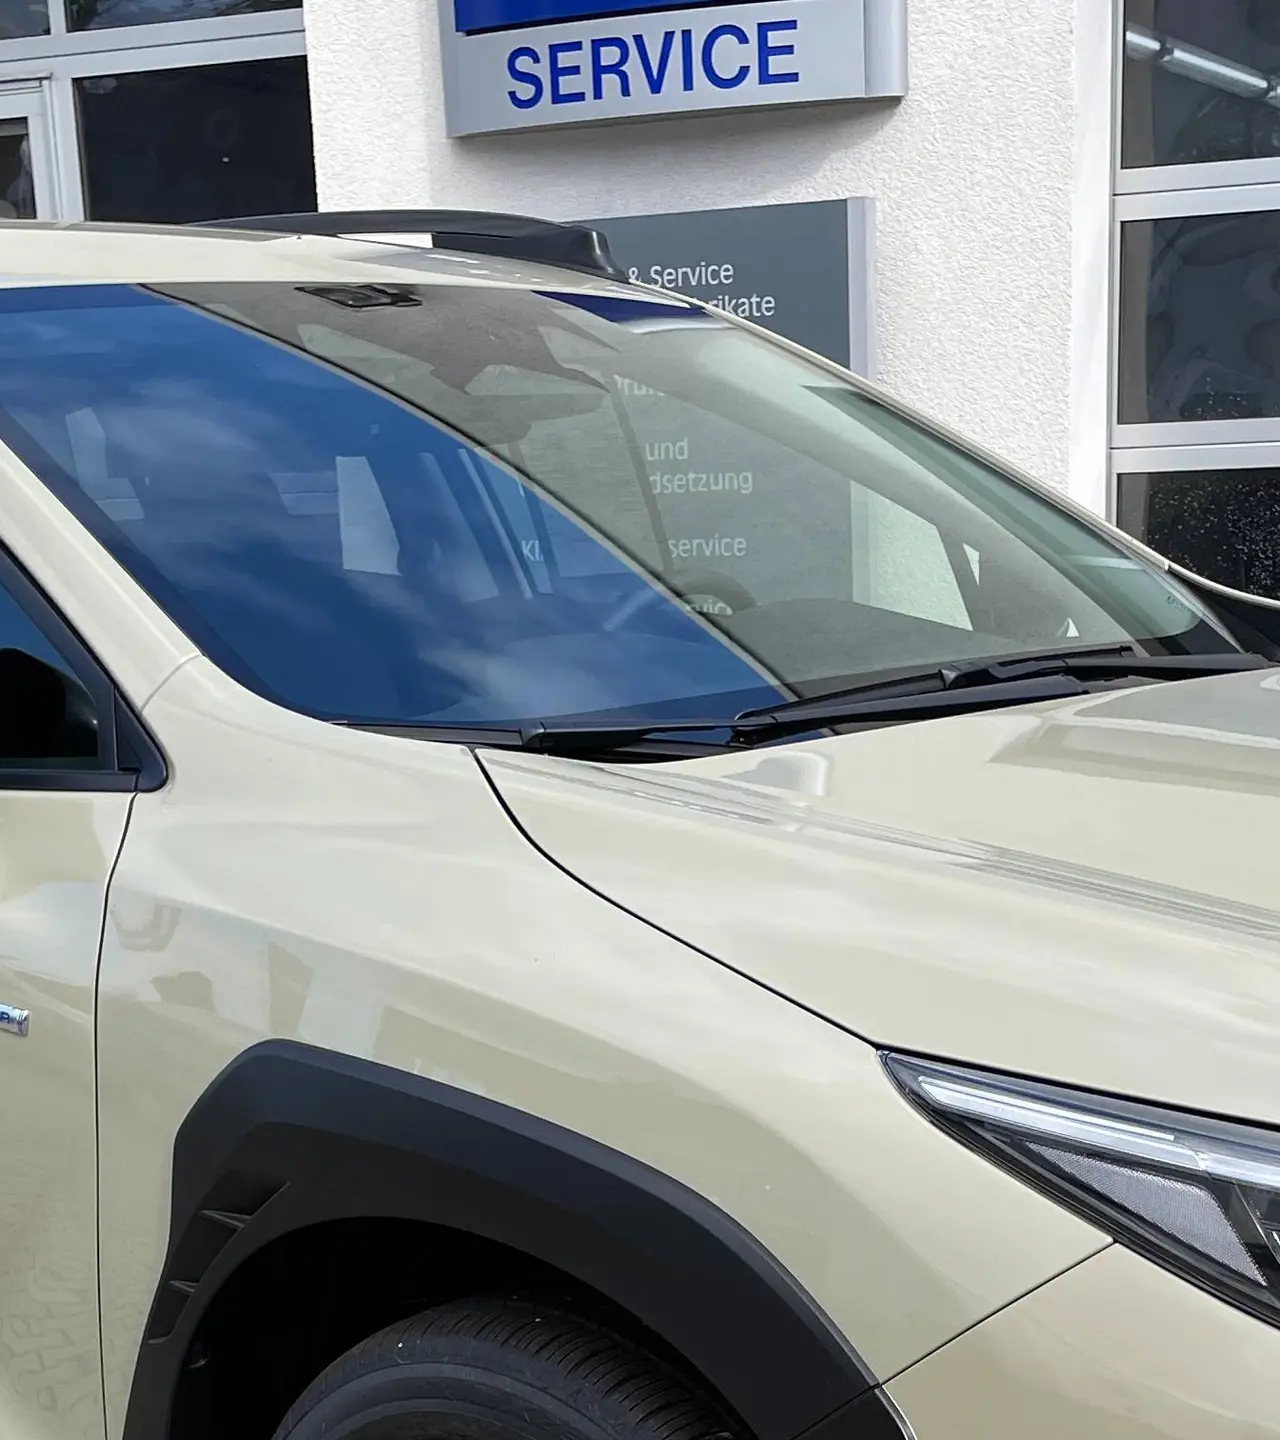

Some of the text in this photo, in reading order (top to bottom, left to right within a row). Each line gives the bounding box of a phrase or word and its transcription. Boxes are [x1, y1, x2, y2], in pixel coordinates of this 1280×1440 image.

[507, 19, 800, 110] SERVICE
[649, 260, 735, 288] Service
[707, 292, 776, 318] rikate
[644, 437, 690, 462] und
[648, 470, 754, 495] dsetzung
[668, 533, 748, 559] service
